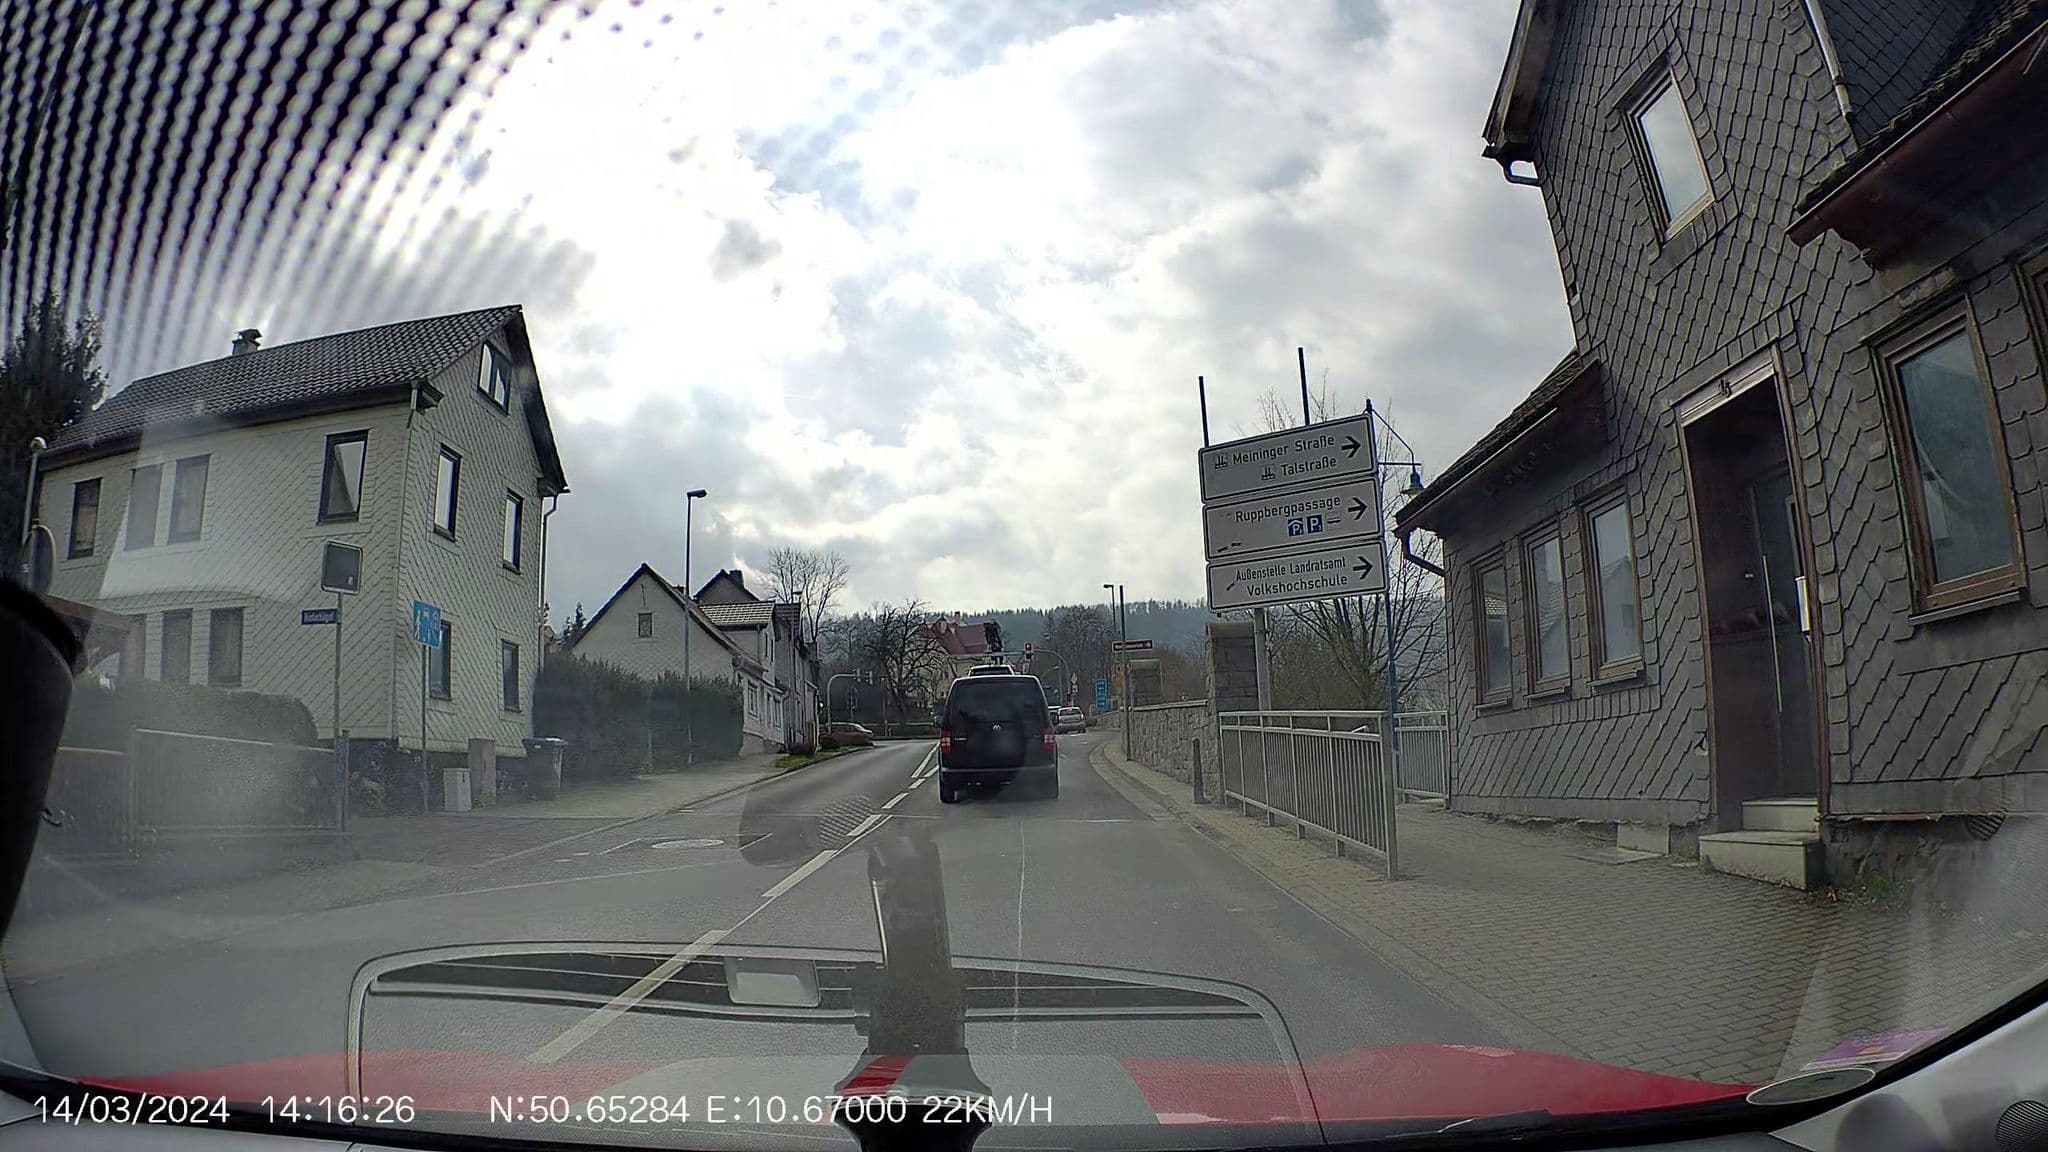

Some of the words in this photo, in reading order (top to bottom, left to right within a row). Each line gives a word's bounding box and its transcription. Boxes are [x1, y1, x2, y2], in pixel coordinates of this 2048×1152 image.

[1233, 443, 1288, 464] Meininger
[1295, 435, 1334, 452] Straße
[1282, 456, 1337, 476] Talstraße
[1235, 494, 1341, 523] Ruppbergpassage
[1236, 562, 1286, 582] Außenstelle
[1290, 556, 1346, 574] Landratsamt
[1246, 576, 1348, 597] Volkshochschule
